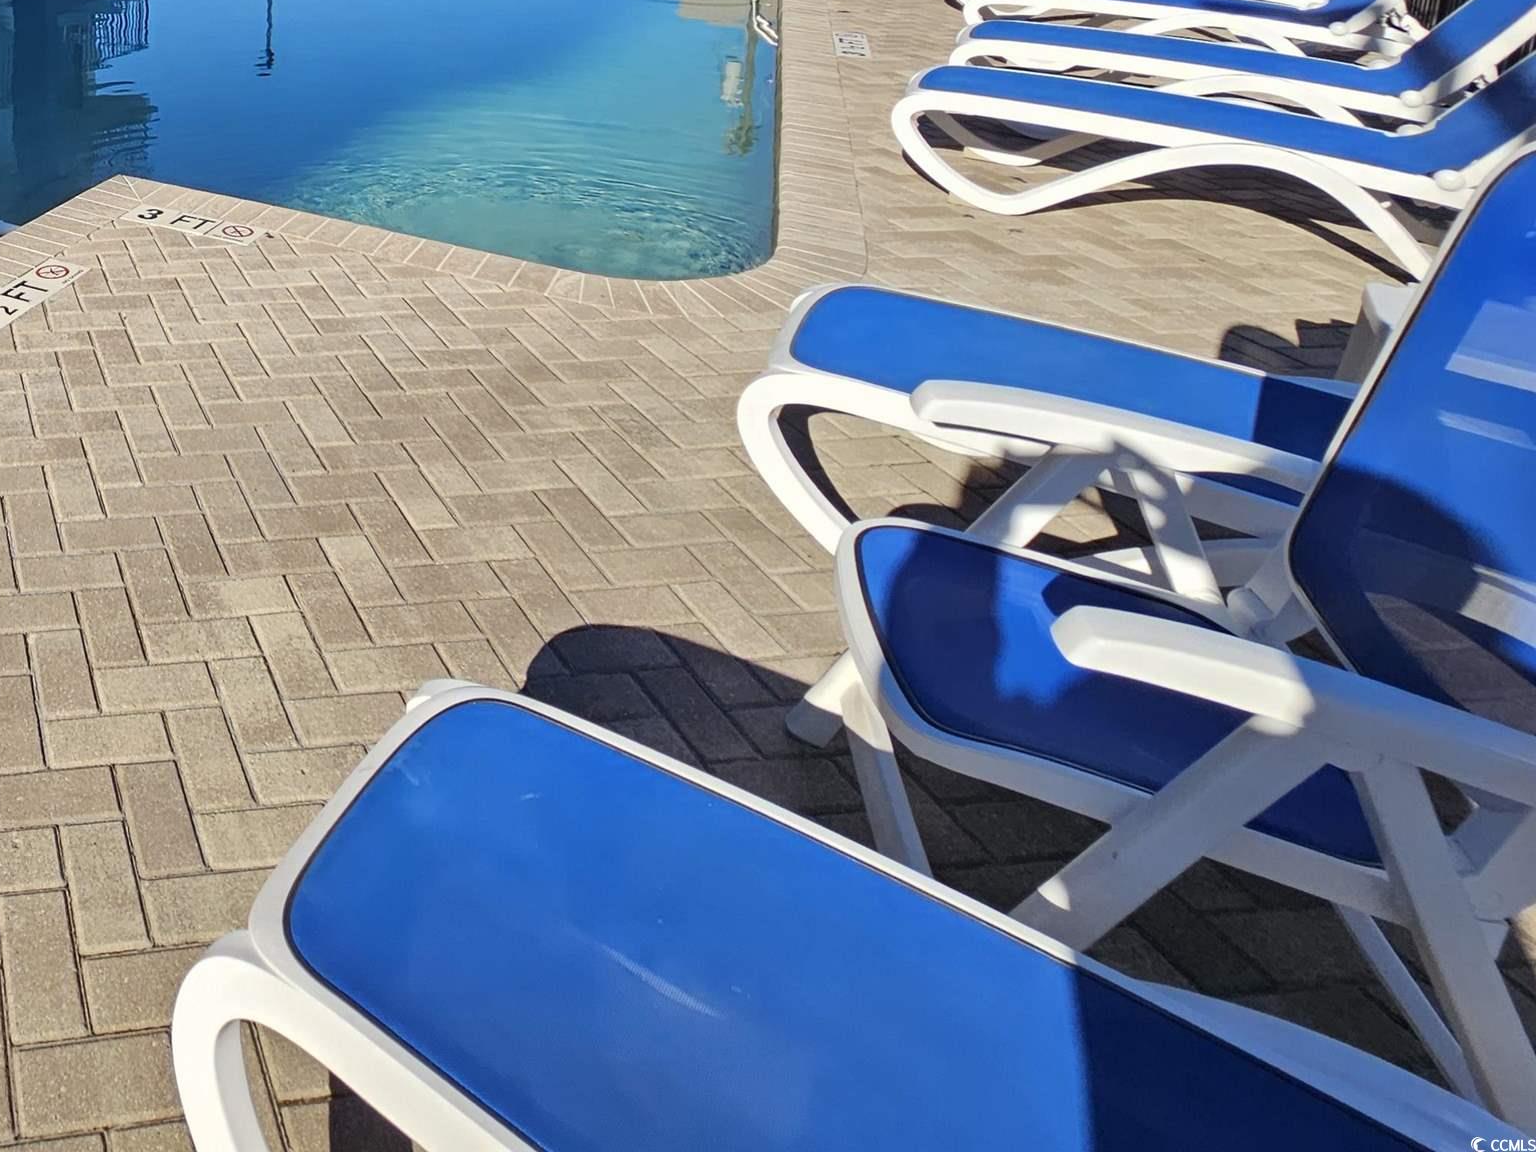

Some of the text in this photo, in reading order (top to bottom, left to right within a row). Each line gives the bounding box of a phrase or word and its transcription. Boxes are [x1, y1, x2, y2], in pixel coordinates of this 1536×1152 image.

[137, 208, 217, 230] 3 FT
[0, 280, 48, 303] FT
